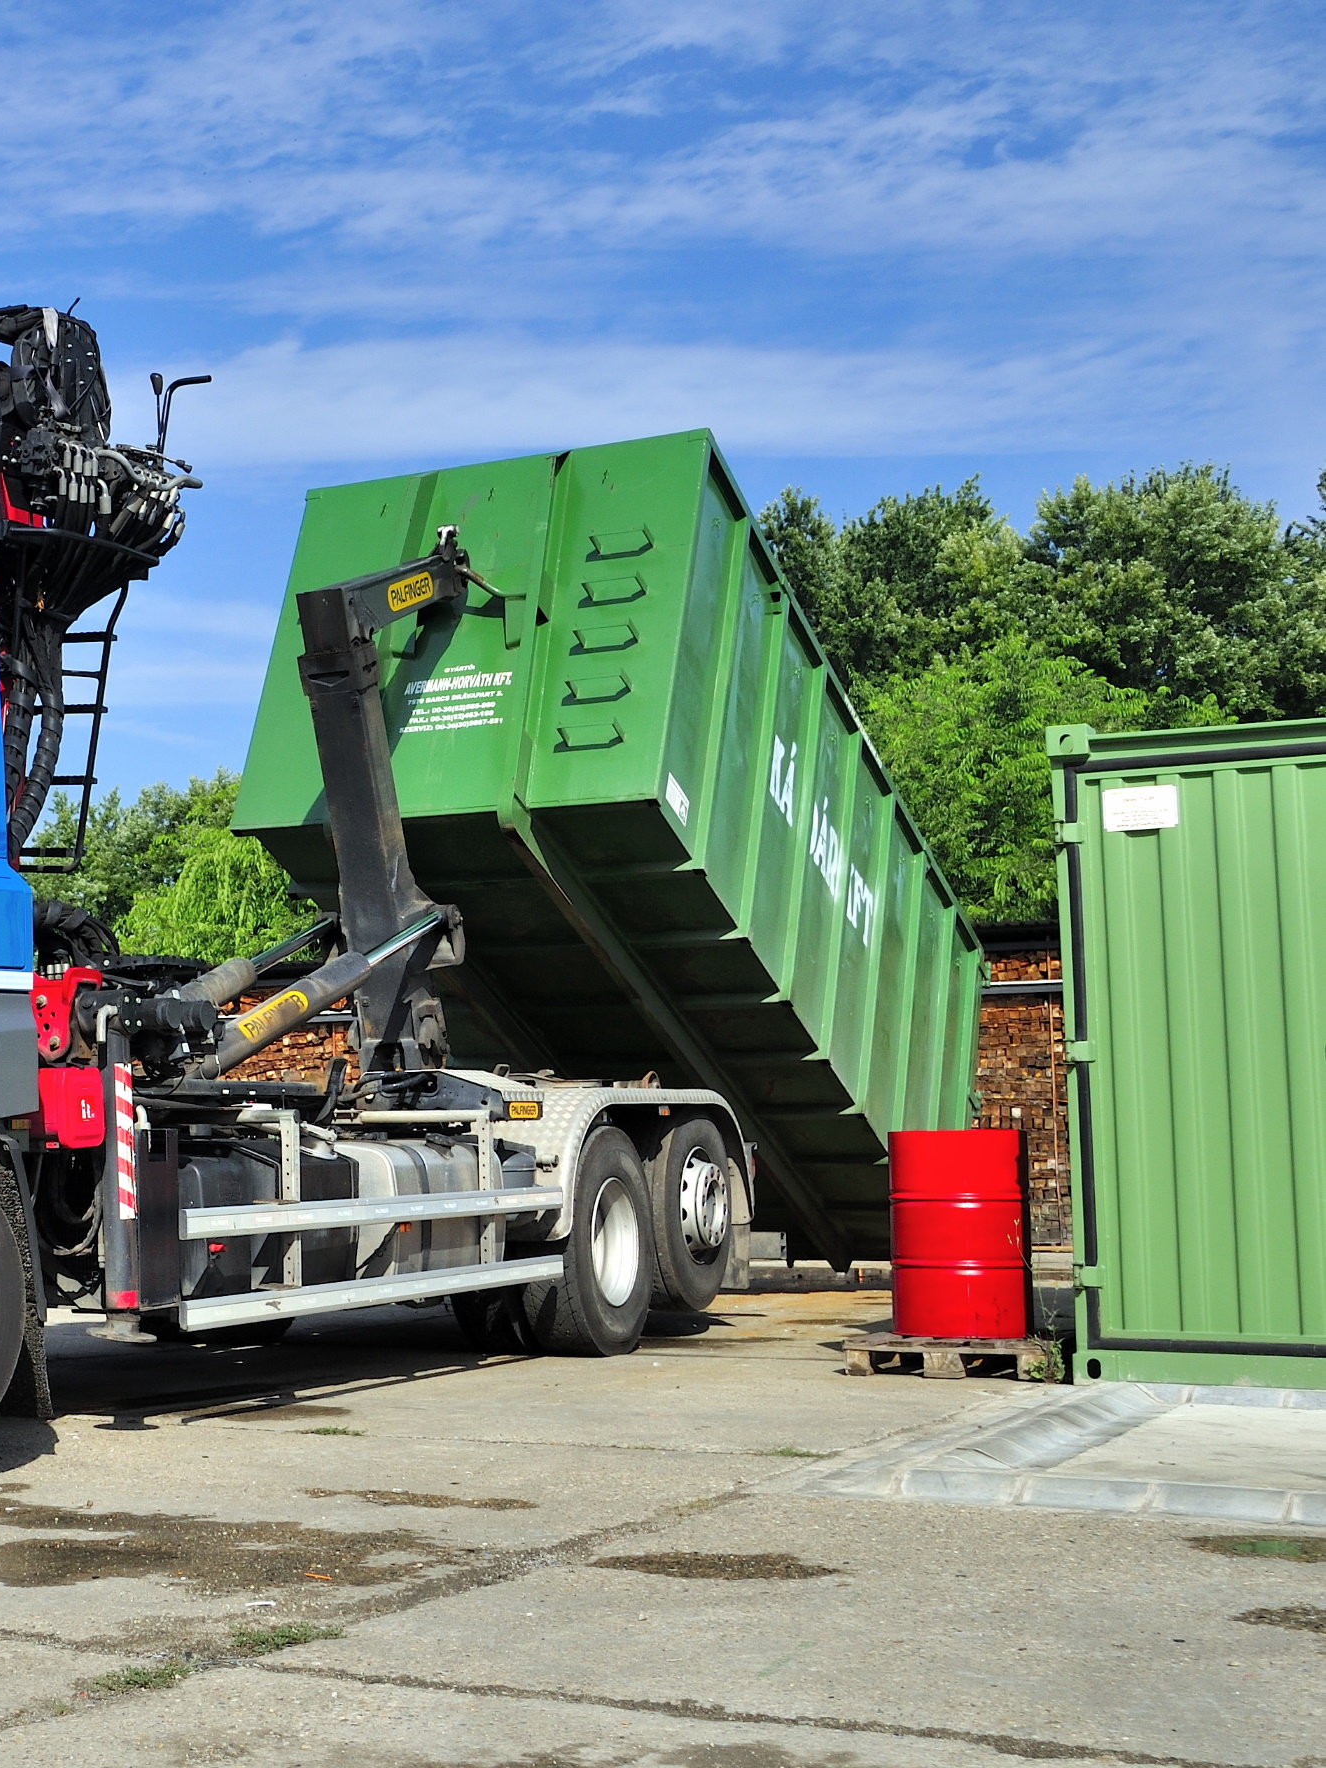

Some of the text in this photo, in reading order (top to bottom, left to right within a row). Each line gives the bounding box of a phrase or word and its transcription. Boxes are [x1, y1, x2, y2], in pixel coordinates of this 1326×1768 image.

[391, 577, 430, 606] PALFINGER
[404, 671, 493, 695] AVERMANN-HORVÁTH
[426, 695, 449, 703] BARCS
